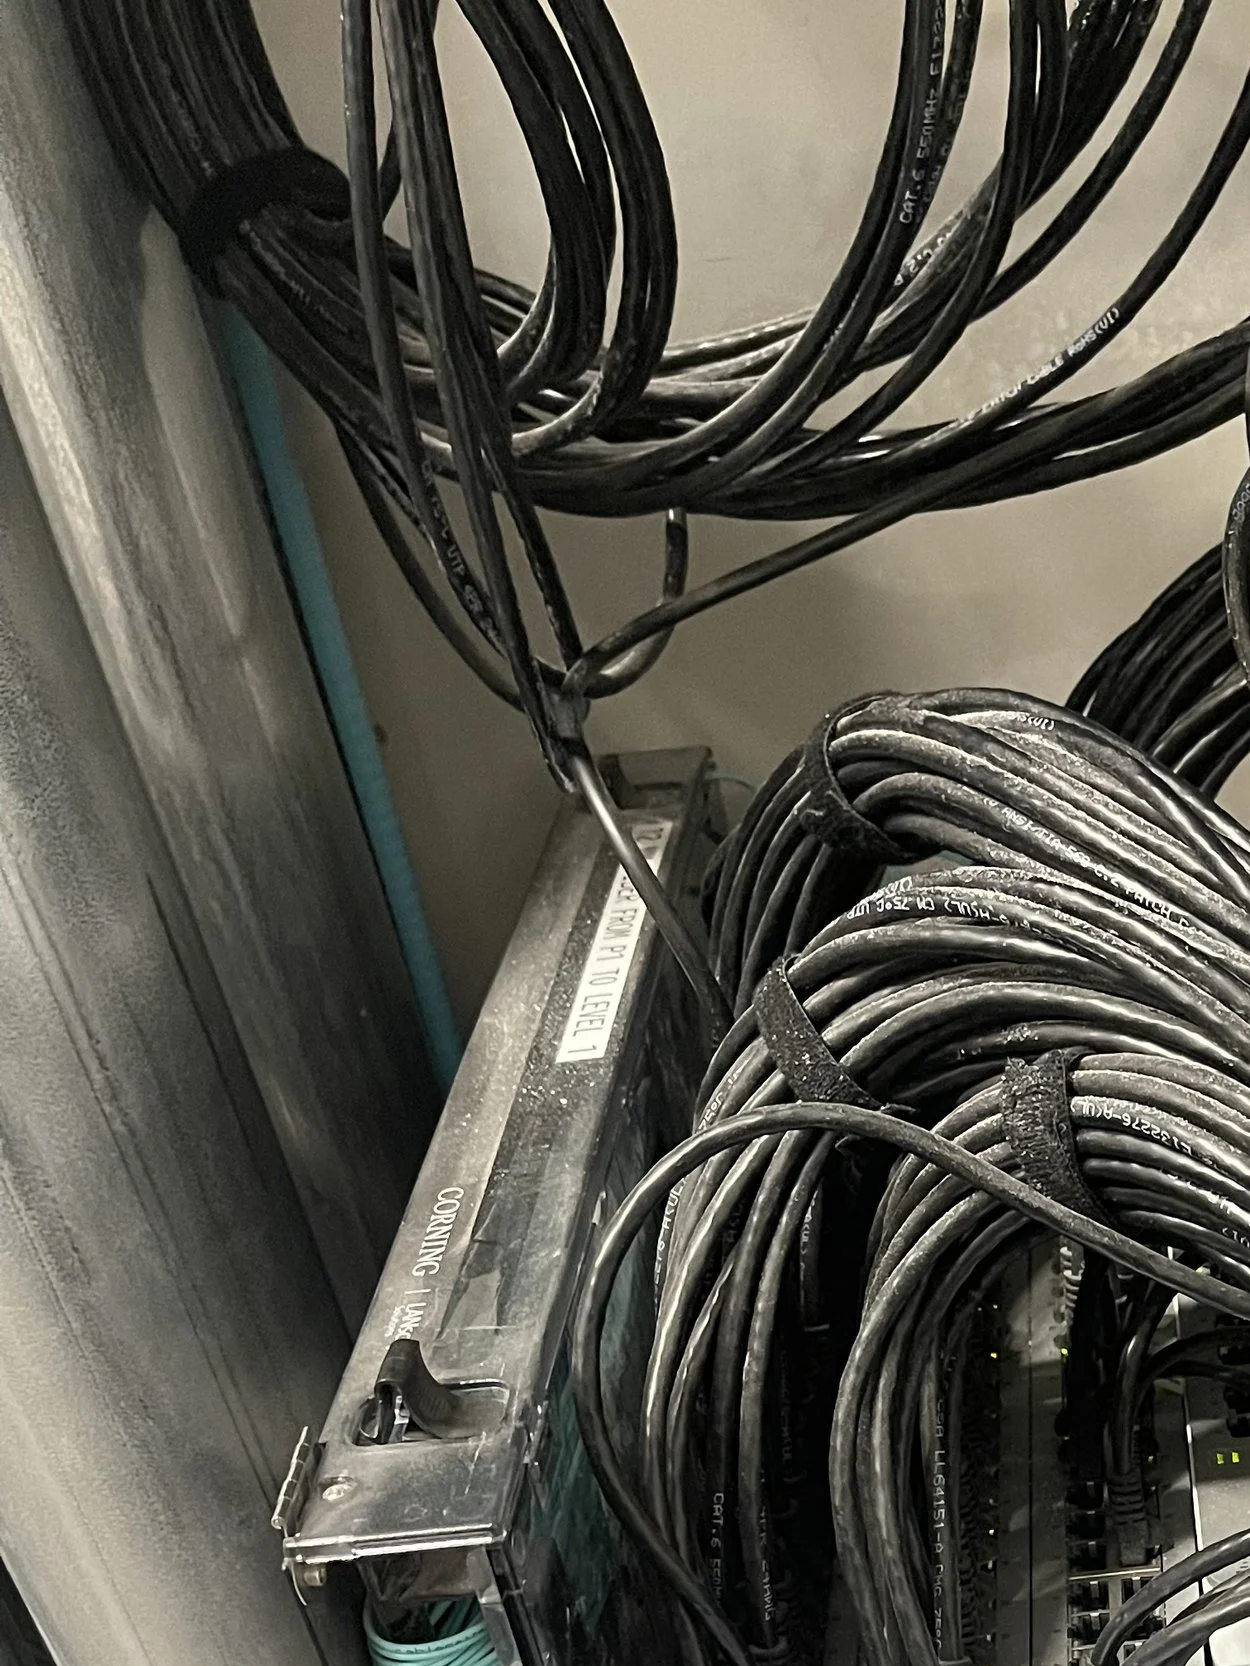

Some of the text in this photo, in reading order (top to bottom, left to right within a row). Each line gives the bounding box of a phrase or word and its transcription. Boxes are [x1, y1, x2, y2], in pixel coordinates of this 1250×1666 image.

[588, 967, 621, 986] TO
[572, 992, 614, 1038] LEVEL
[410, 1186, 465, 1278] CORNING
